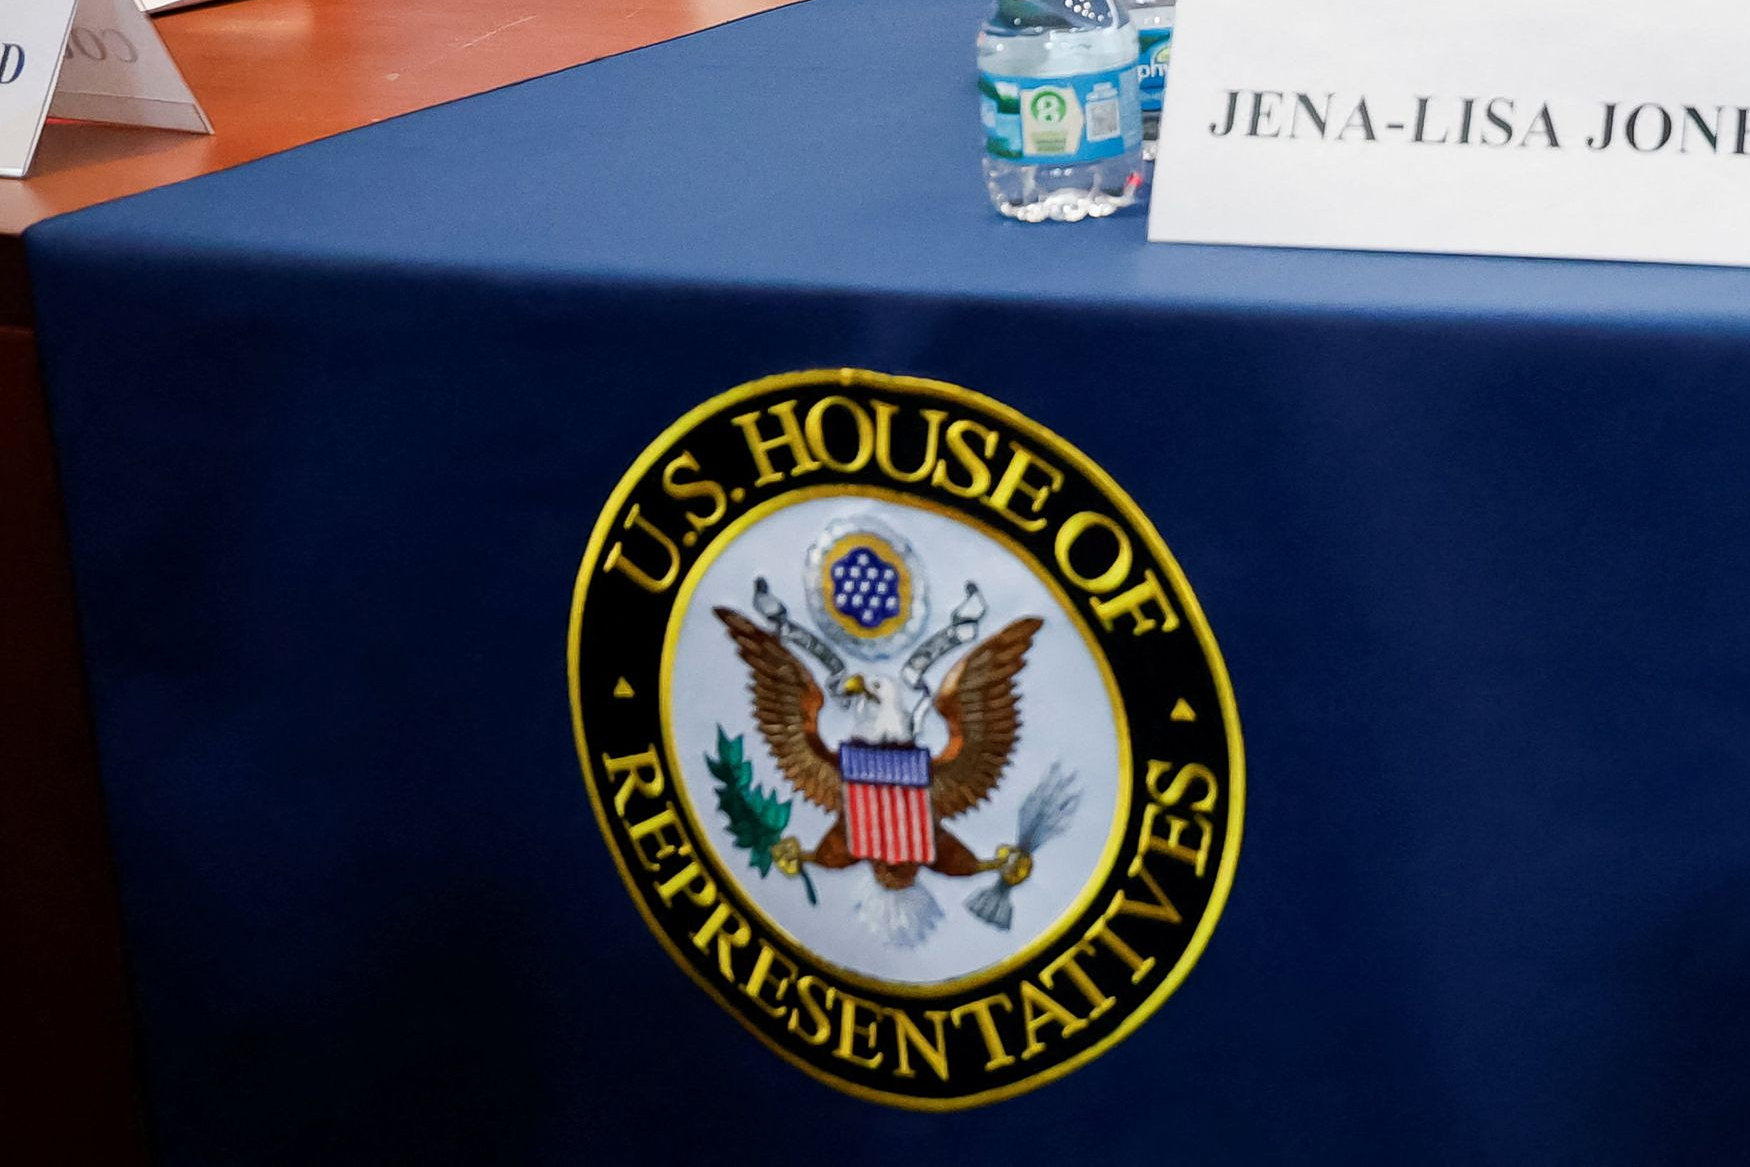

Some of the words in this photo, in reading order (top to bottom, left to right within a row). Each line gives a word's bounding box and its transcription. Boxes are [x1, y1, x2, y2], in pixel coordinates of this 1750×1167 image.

[1208, 89, 1562, 150] JENA-LISA
[602, 451, 747, 594] U.S.
[730, 394, 1067, 533] HOUSE
[1054, 509, 1180, 636] OF
[602, 743, 1219, 1082] REPRESENTATIVES
